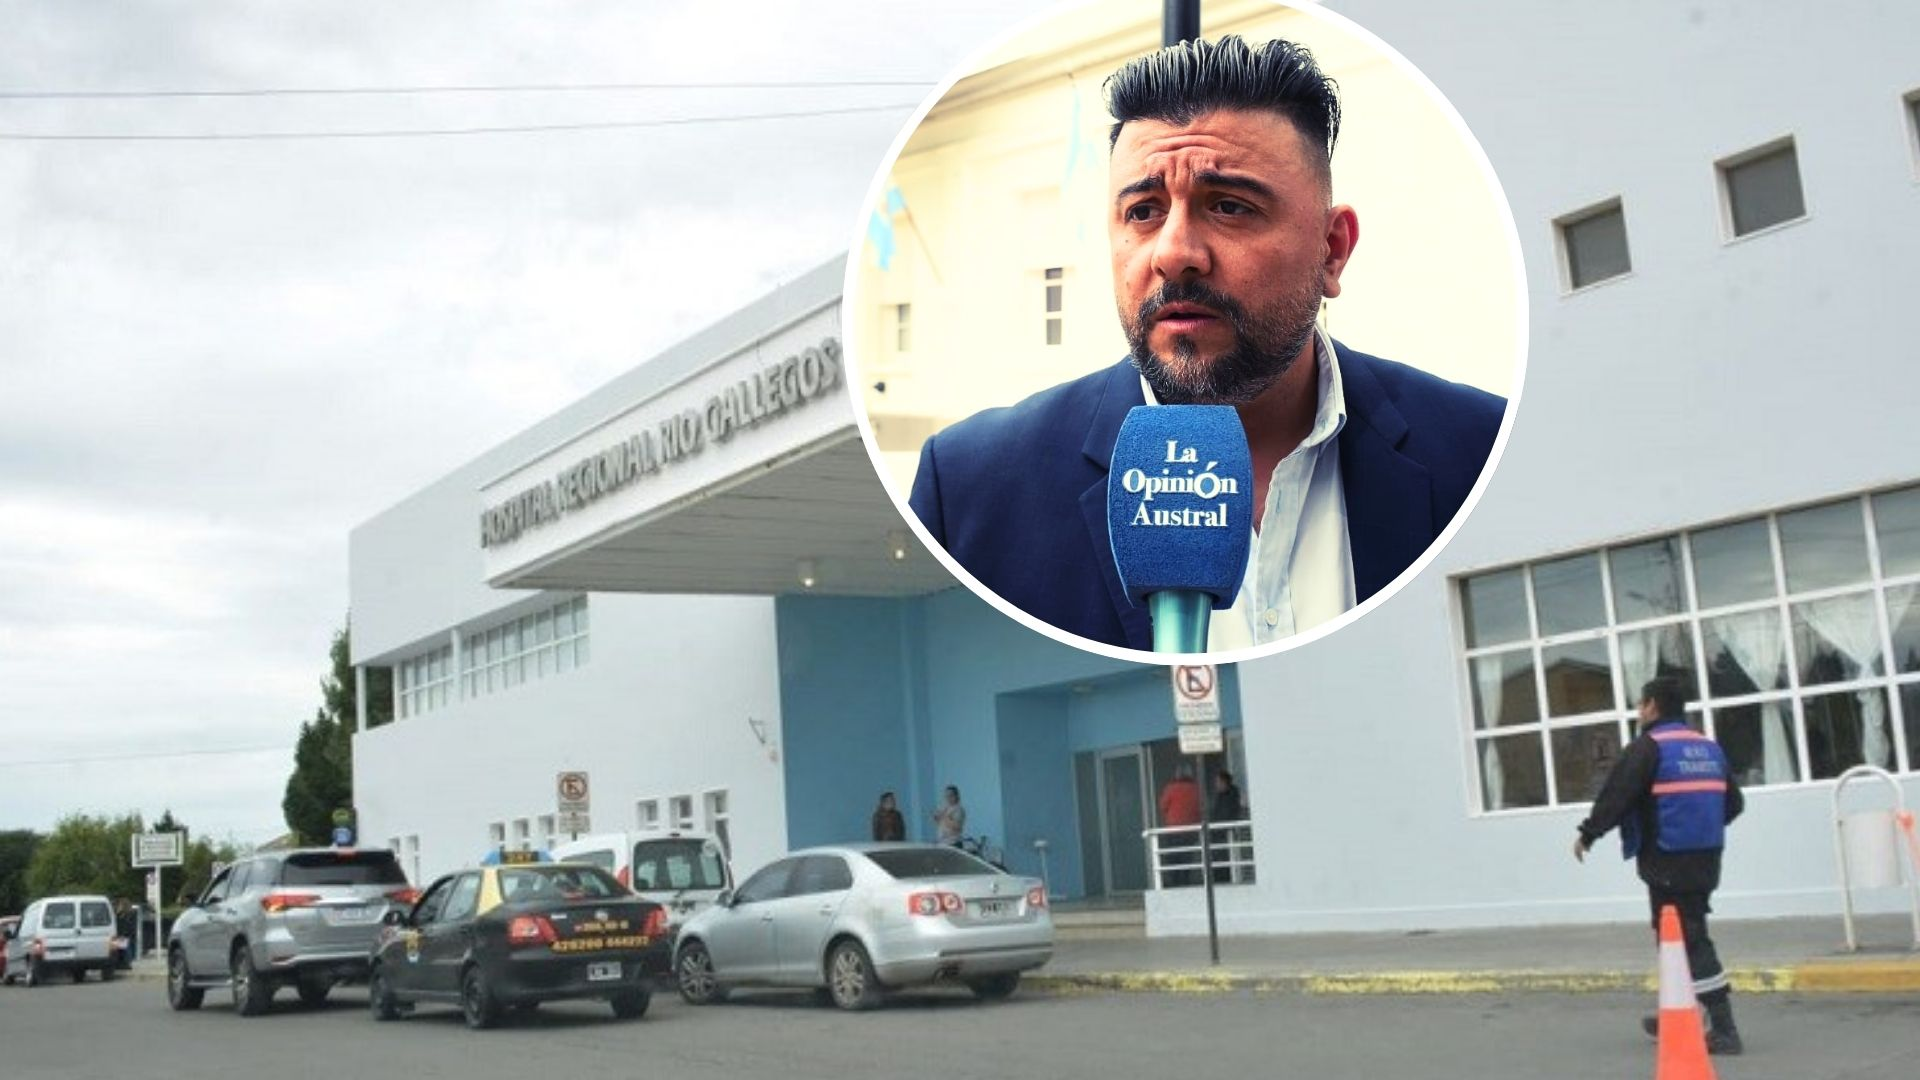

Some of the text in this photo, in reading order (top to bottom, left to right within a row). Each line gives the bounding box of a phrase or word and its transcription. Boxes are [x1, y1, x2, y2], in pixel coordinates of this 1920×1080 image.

[480, 480, 559, 548] HOSPITAL
[556, 430, 660, 511] REGIONAL
[704, 337, 843, 443] GALLEGOS
[1164, 440, 1198, 463] La
[1131, 501, 1228, 527] Austral
